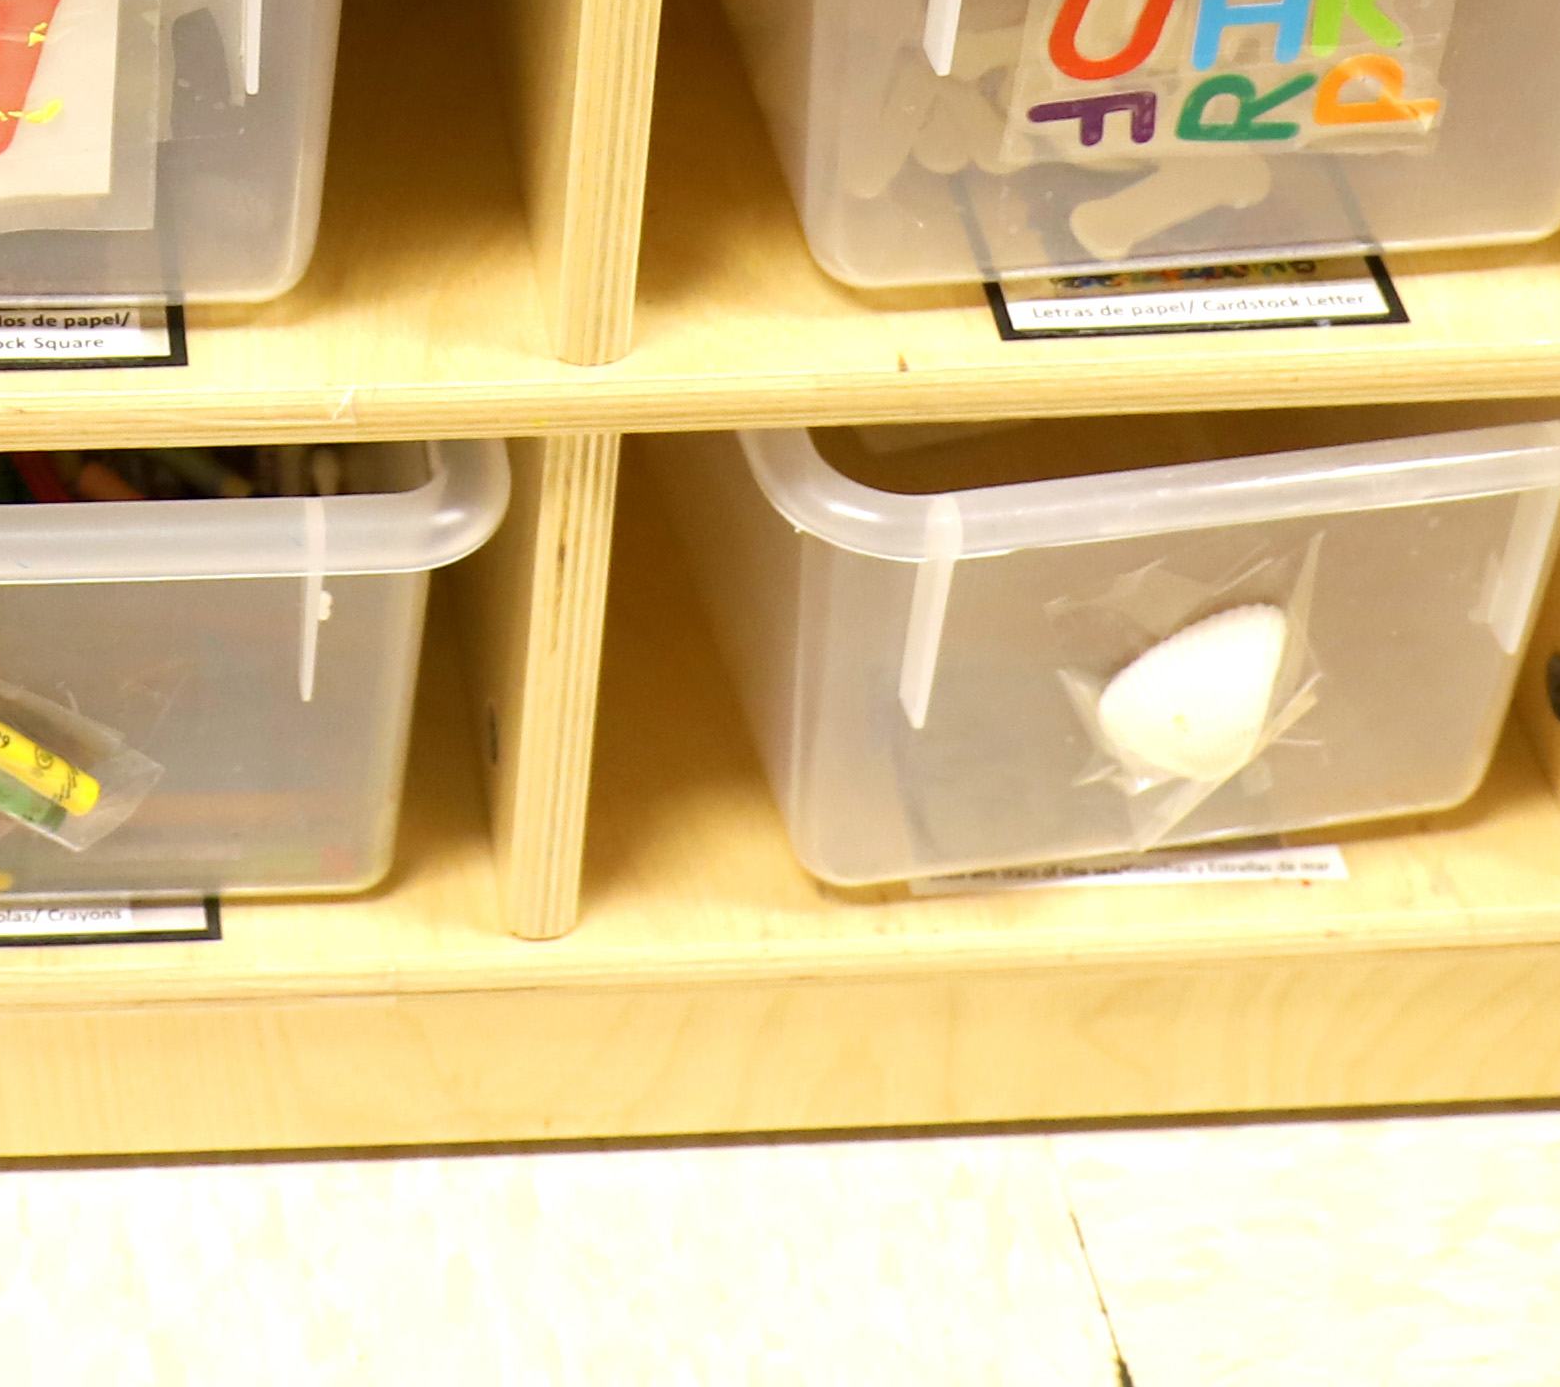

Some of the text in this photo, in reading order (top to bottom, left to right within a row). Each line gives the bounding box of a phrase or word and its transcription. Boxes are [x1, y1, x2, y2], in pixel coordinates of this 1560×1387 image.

[1033, 294, 1364, 318] Letras de papel/ Cardstock Letter
[32, 315, 56, 328] de
[64, 312, 130, 329] papel/
[34, 337, 104, 351] Square
[48, 908, 122, 923] Crayons
